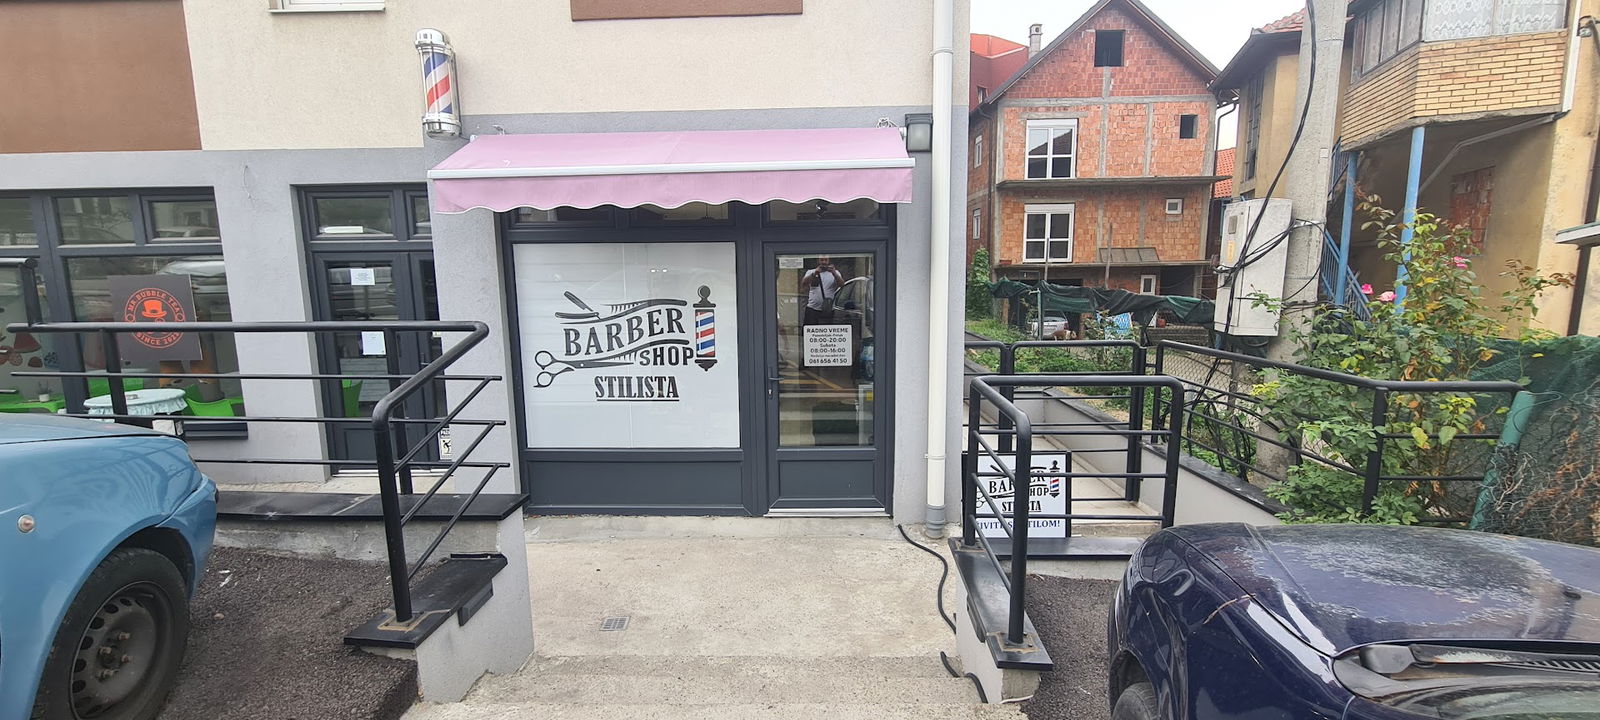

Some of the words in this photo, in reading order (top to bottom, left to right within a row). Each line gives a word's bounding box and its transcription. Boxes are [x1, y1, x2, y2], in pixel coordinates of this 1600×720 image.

[168, 296, 180, 313] TEA
[136, 332, 161, 345] SINCE
[563, 308, 686, 357] BARBER
[639, 346, 694, 366] SHOP
[594, 375, 680, 399] STILISTA
[989, 470, 1045, 493] BAR
[1027, 487, 1050, 497] HOP
[1002, 500, 1041, 512] STTA
[977, 520, 1003, 530] IVIT
[1027, 519, 1061, 529] TILOM!
